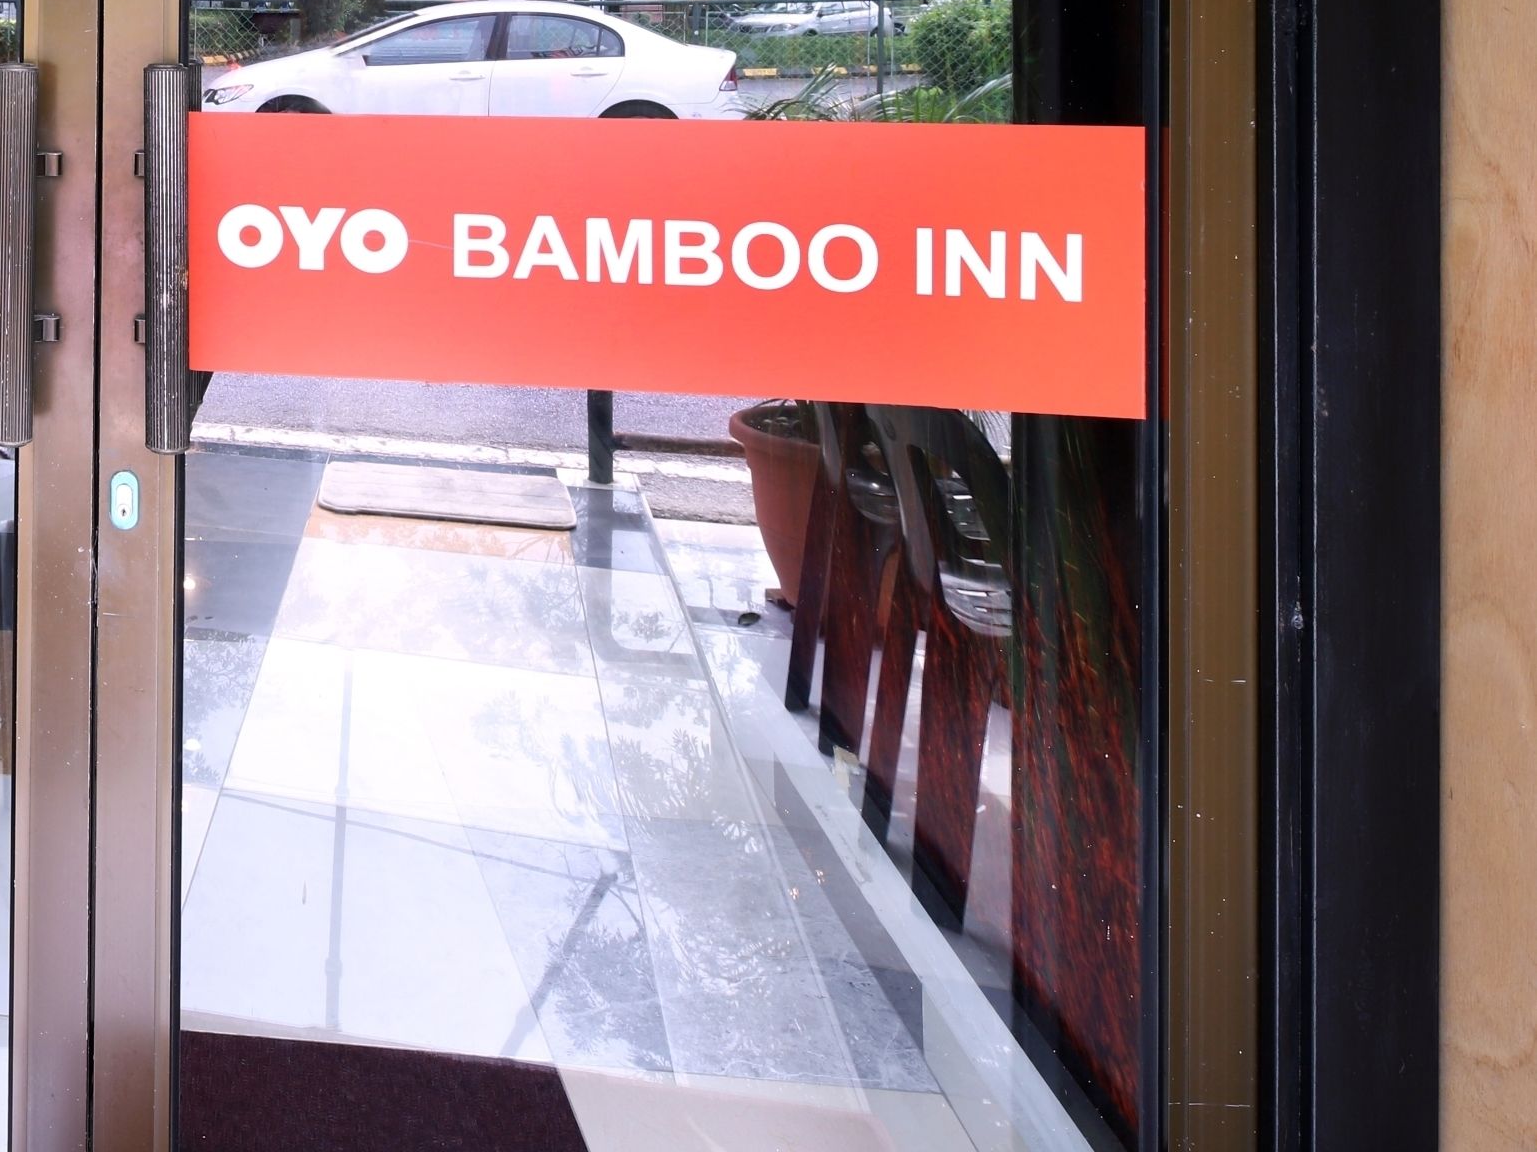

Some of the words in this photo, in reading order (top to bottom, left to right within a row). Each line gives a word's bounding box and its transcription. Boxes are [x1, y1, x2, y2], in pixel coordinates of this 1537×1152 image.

[216, 203, 409, 275] OYO
[451, 211, 879, 295] BAMBOO
[914, 226, 1085, 304] INN
